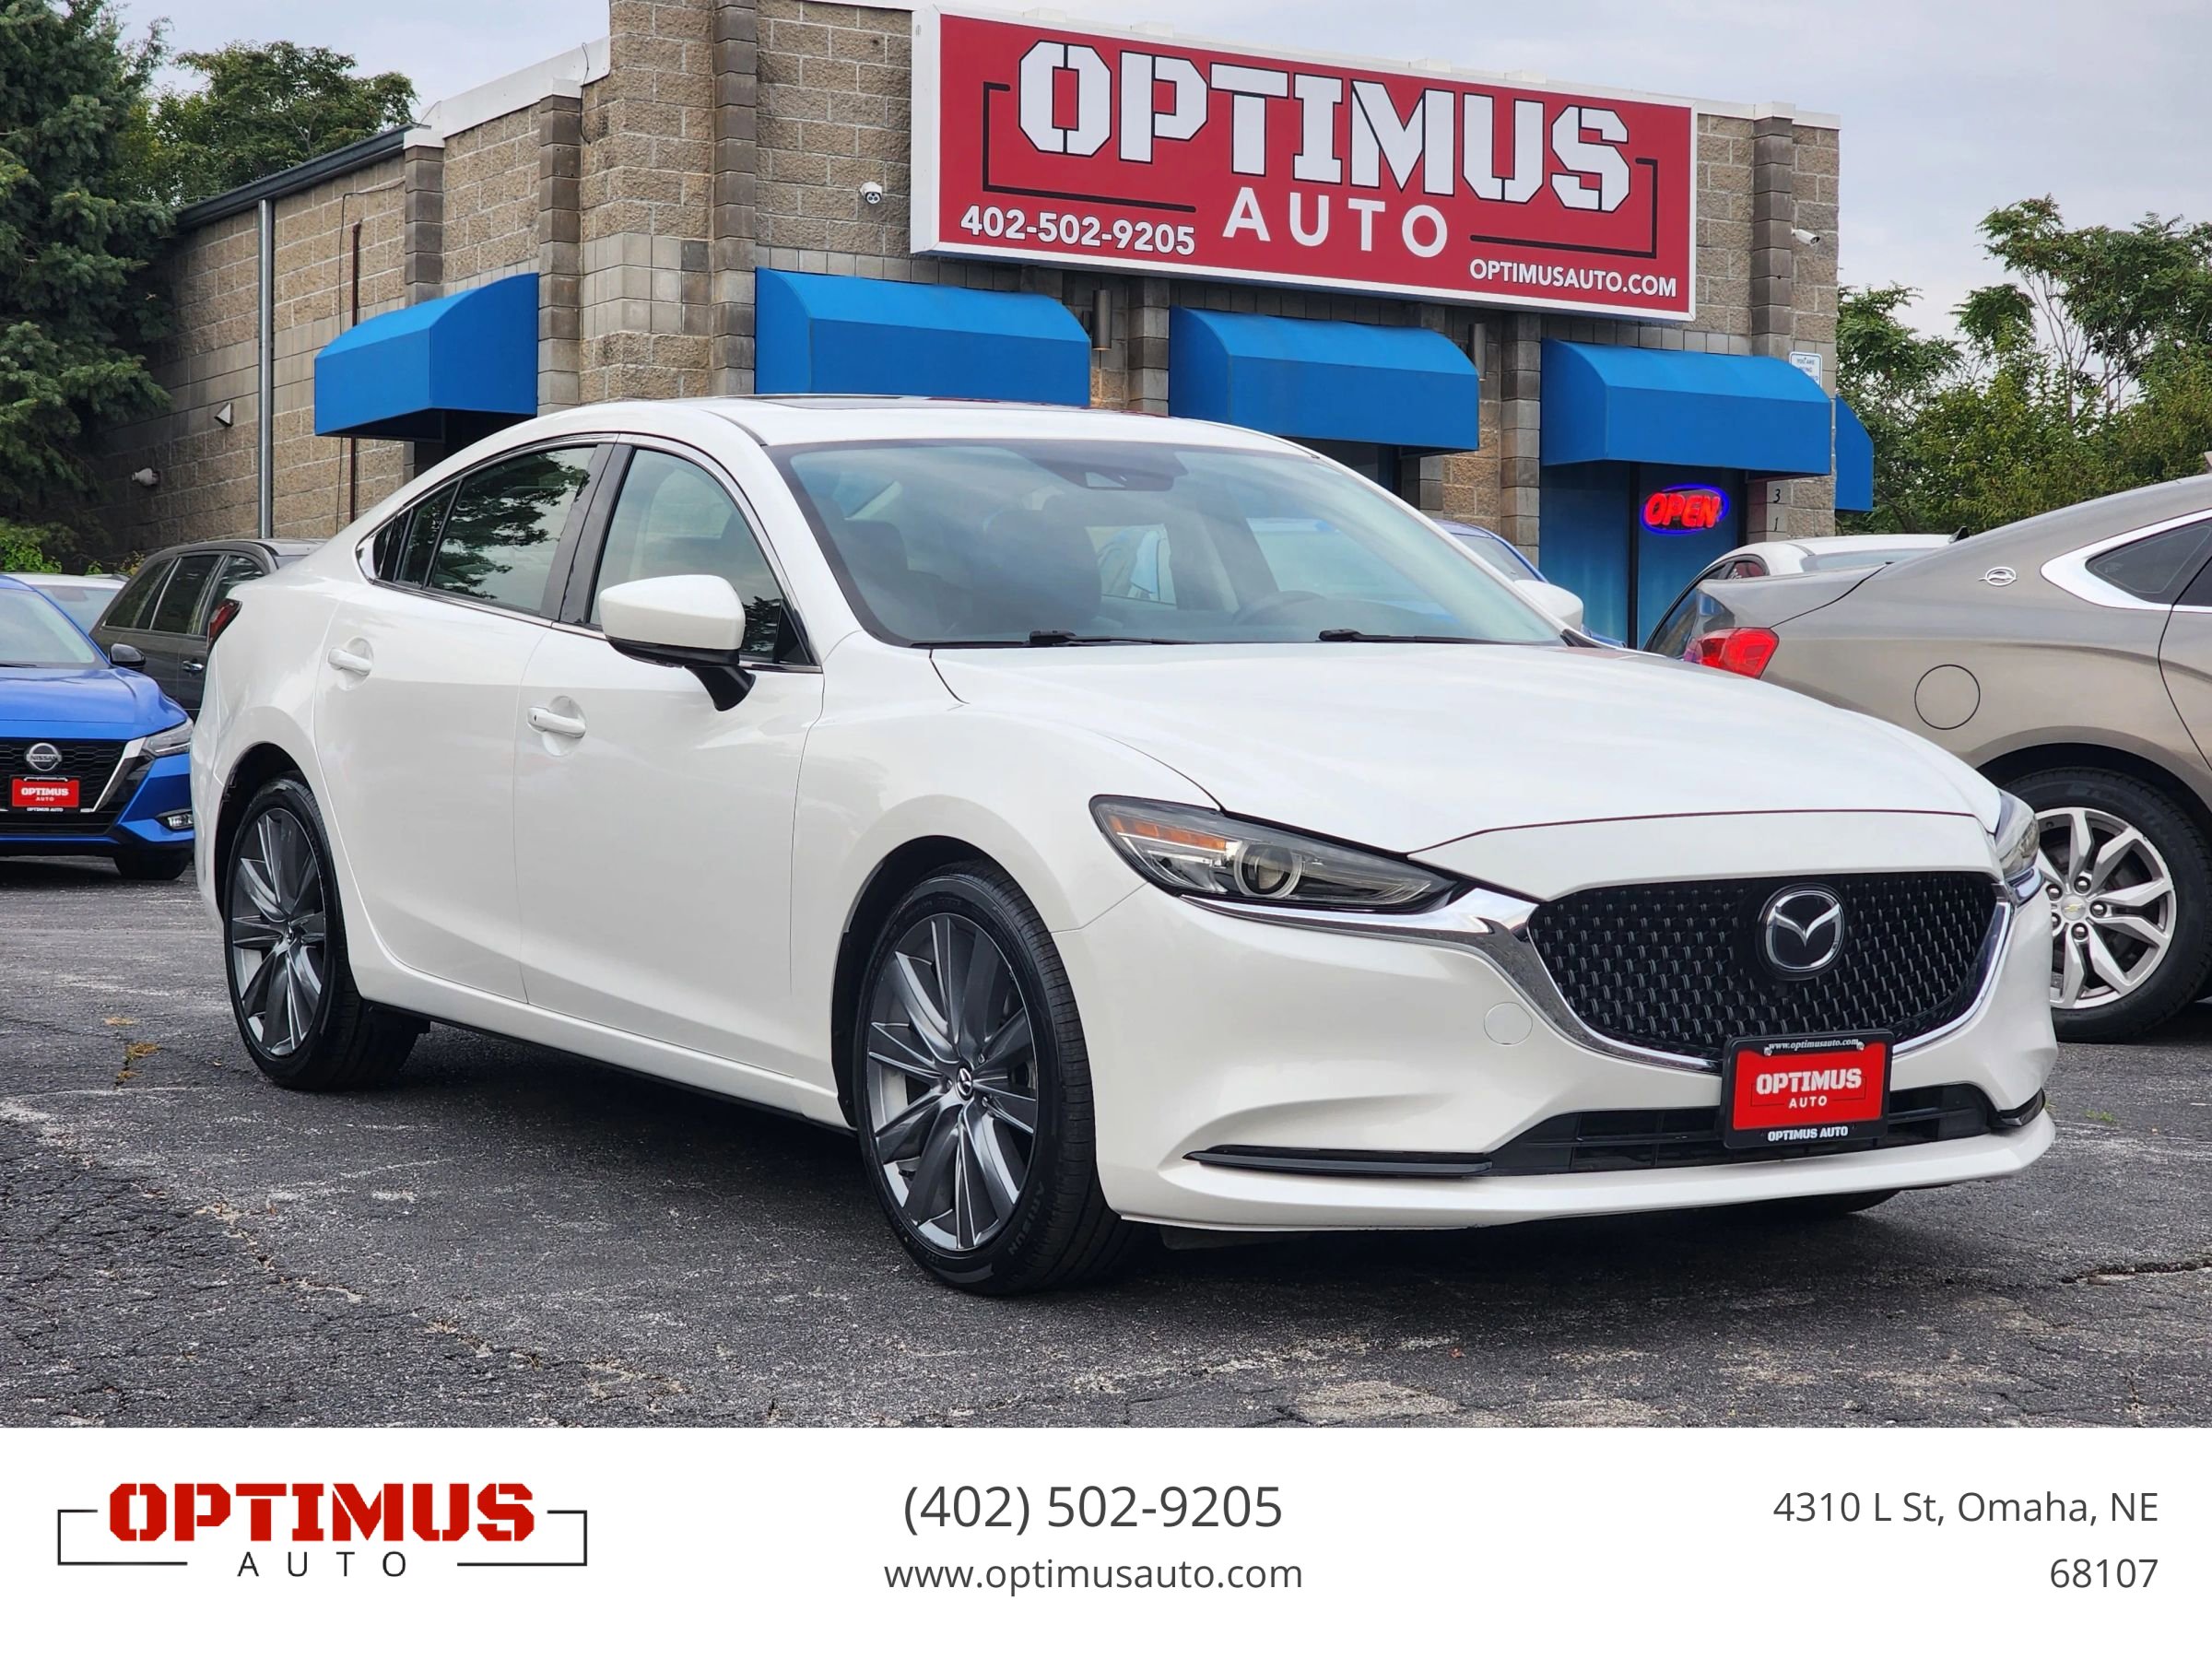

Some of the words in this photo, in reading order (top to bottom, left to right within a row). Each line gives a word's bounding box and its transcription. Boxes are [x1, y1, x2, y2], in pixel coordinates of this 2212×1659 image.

[1018, 40, 1631, 214] OPTIMUS
[960, 205, 1195, 256] 402-502-9205
[1222, 187, 1448, 259] AUTO
[1469, 259, 1677, 298] OPTIMUSAUTO.COM
[1773, 488, 1782, 503] 3
[1645, 492, 1721, 528] OPEN
[20, 787, 70, 796] OPTIMUS
[1769, 1038, 1859, 1052] www.optimusauto.com
[1756, 1067, 1862, 1095] OPTIMUS
[1788, 1095, 1828, 1109] AUTO
[1767, 1128, 1818, 1142] OPTIMUS
[1819, 1125, 1849, 1138] AUTO
